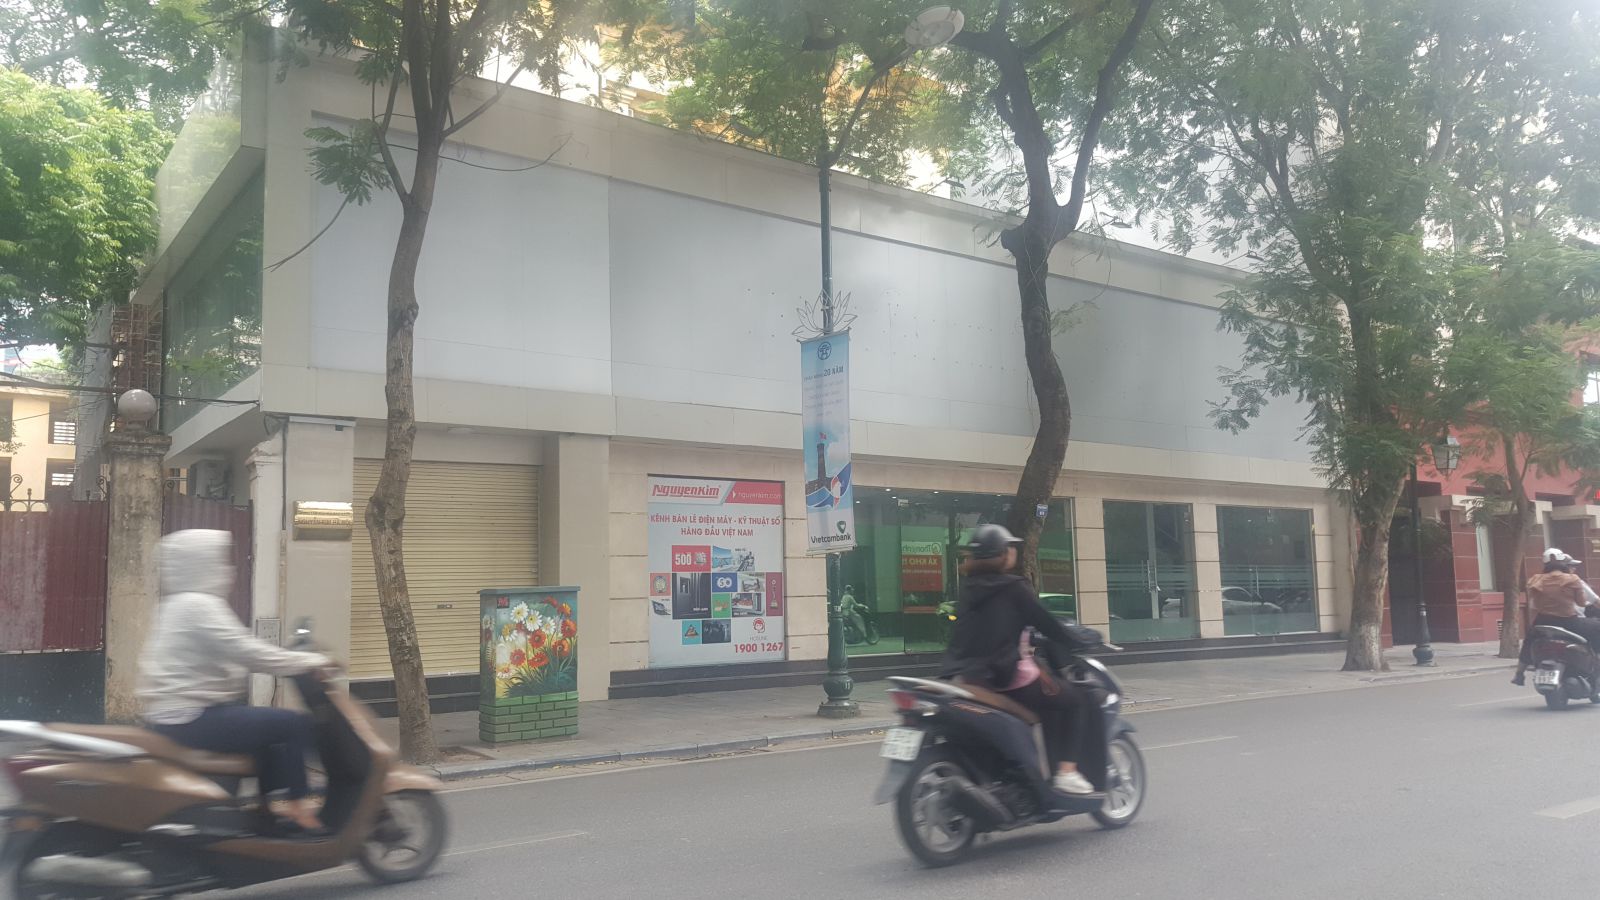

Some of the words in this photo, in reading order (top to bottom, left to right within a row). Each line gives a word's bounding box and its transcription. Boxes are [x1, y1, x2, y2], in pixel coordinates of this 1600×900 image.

[650, 512, 670, 523] KÊNH
[716, 514, 733, 524] MÁY
[749, 516, 769, 527] THUẬT
[771, 515, 781, 525] SỐ
[680, 526, 703, 536] HÀNG
[721, 526, 736, 539] VIỆT
[737, 528, 754, 537] NAM
[810, 531, 852, 544] Vietcombank
[675, 553, 692, 566] 500
[734, 643, 758, 653] 1900
[760, 642, 784, 652] 1267
